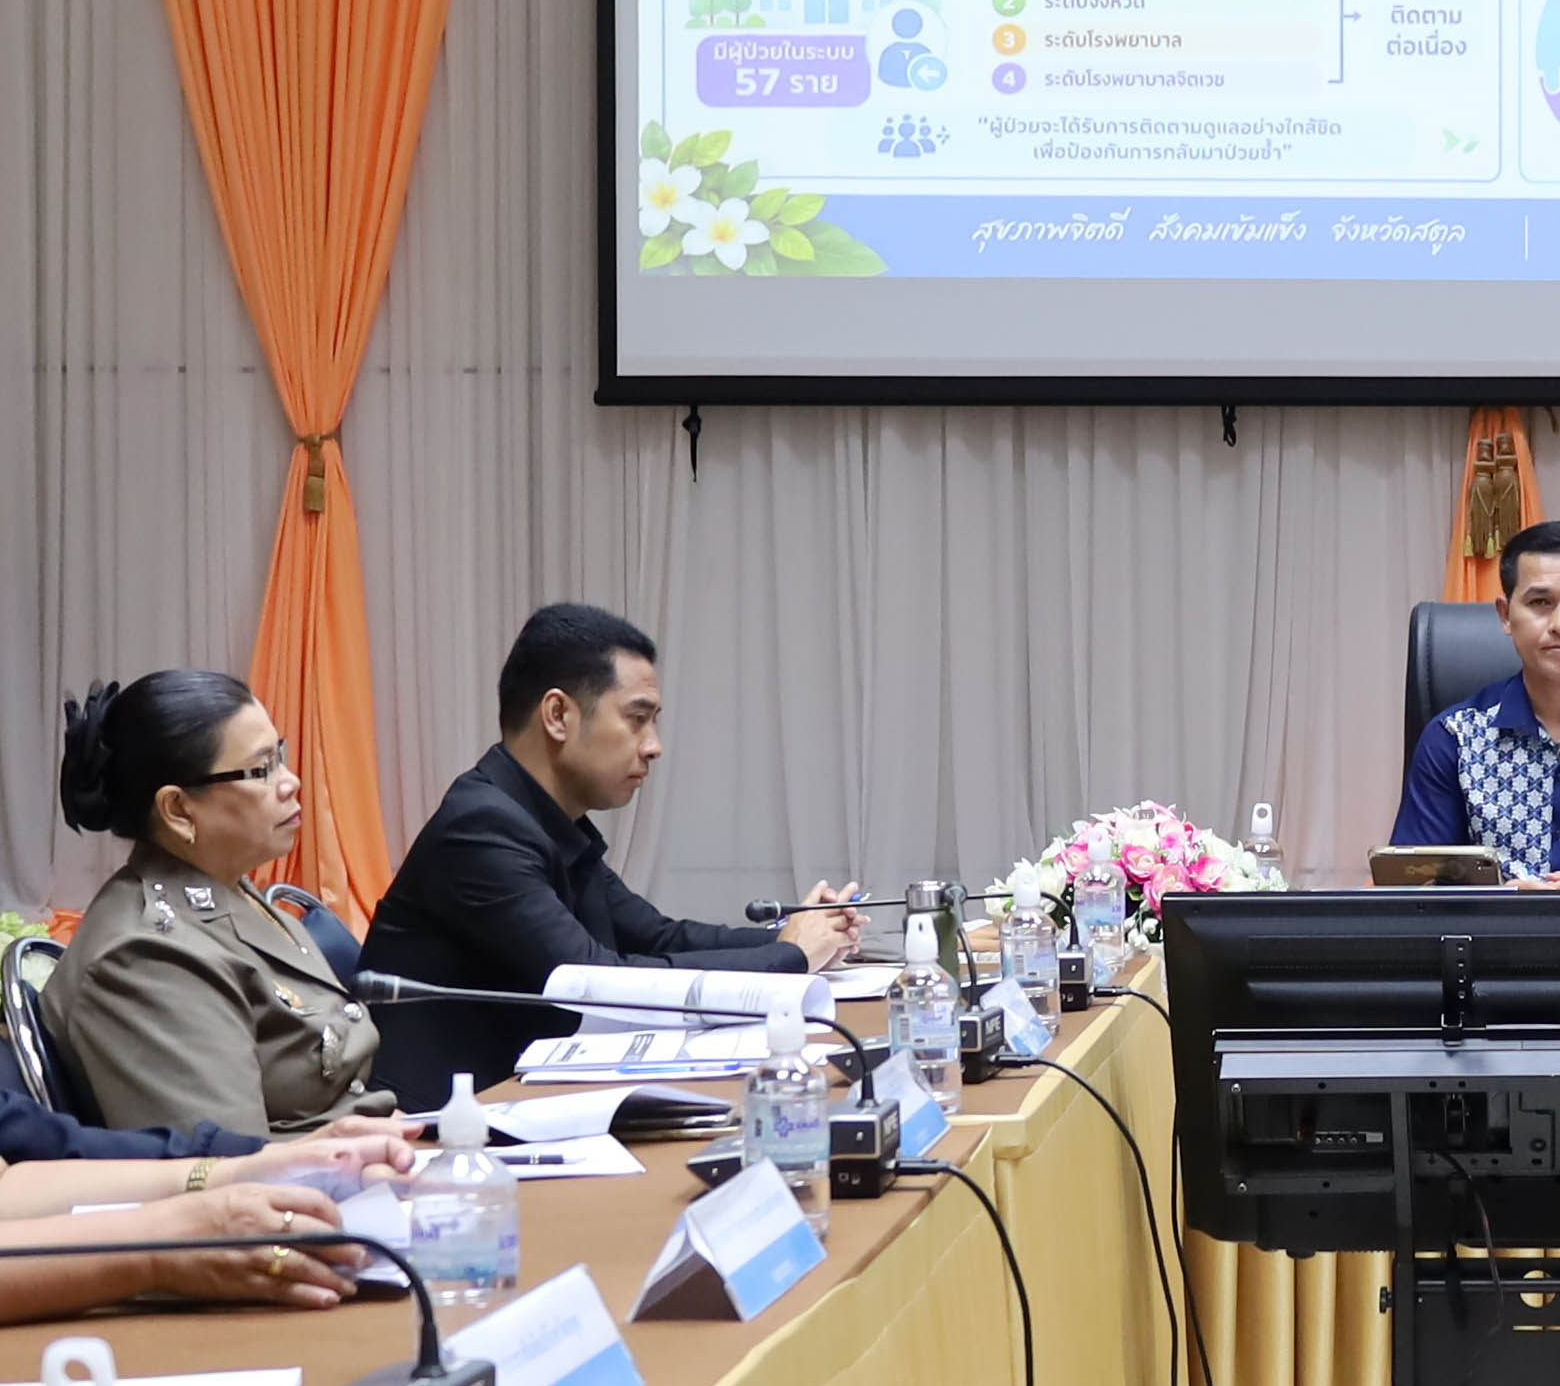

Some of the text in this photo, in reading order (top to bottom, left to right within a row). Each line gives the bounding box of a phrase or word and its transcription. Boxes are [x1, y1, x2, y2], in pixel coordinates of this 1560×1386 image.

[1390, 4, 1463, 26] ติดตาม
[1003, 31, 1016, 48] 3
[1044, 30, 1183, 49] ระดับโรงพยาบาล
[1386, 30, 1468, 57] ต่อเนื่อง
[713, 40, 855, 66] มีผู้ป่วยในระบบ
[735, 68, 839, 97] 57 ราย
[1002, 70, 1017, 87] 4
[1044, 69, 1225, 88] ระดับโรงพยาบาลจิตเวช
[971, 206, 1467, 256] สุขภาพจิตดี สังคมเข้มแข็ง จังหวัดสตูล
